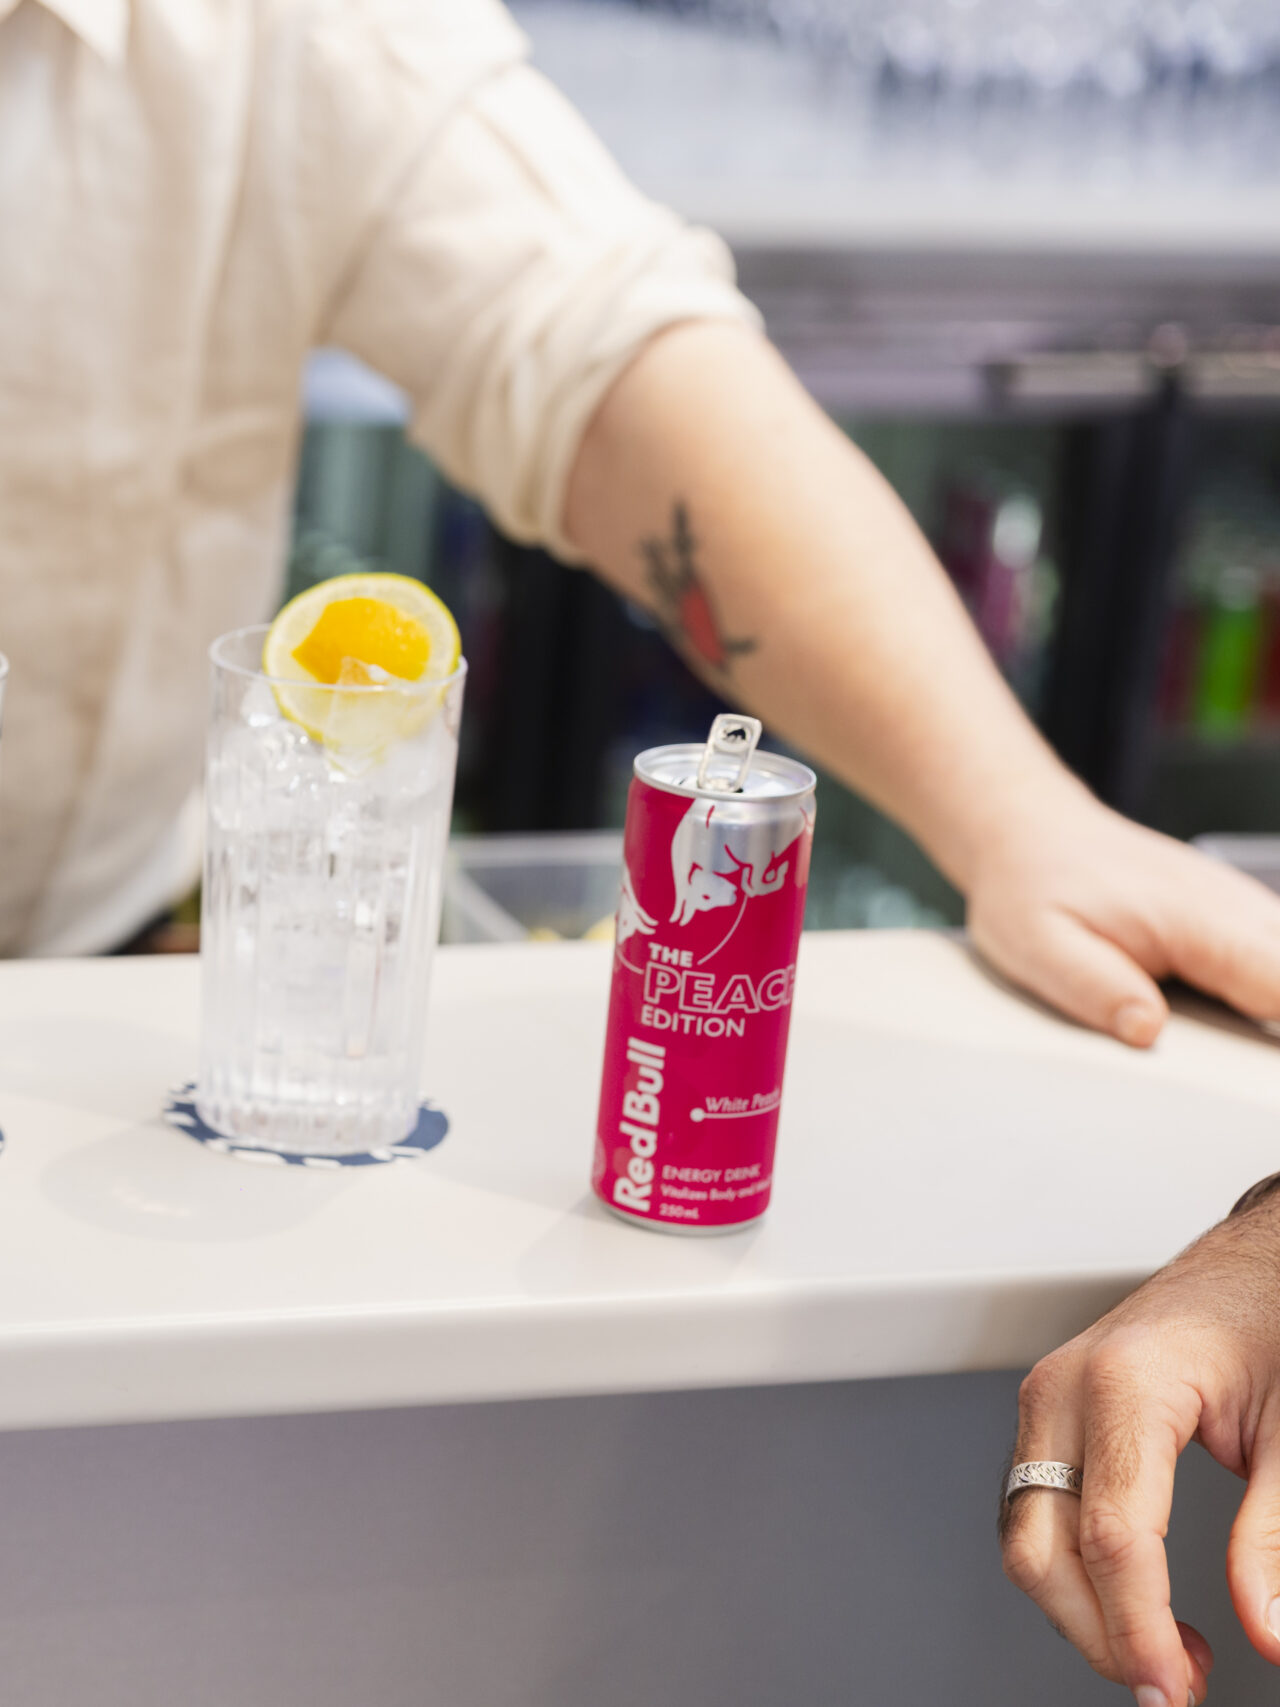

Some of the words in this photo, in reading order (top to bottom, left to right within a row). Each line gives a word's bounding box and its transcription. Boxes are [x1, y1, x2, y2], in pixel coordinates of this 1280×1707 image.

[648, 942, 693, 968] THE
[641, 1004, 746, 1037] EDITION
[622, 1036, 666, 1126] Bull
[705, 1096, 750, 1113] White
[613, 1120, 658, 1212] Red
[662, 1164, 722, 1183] ENERGY
[724, 1163, 762, 1183] DRINK
